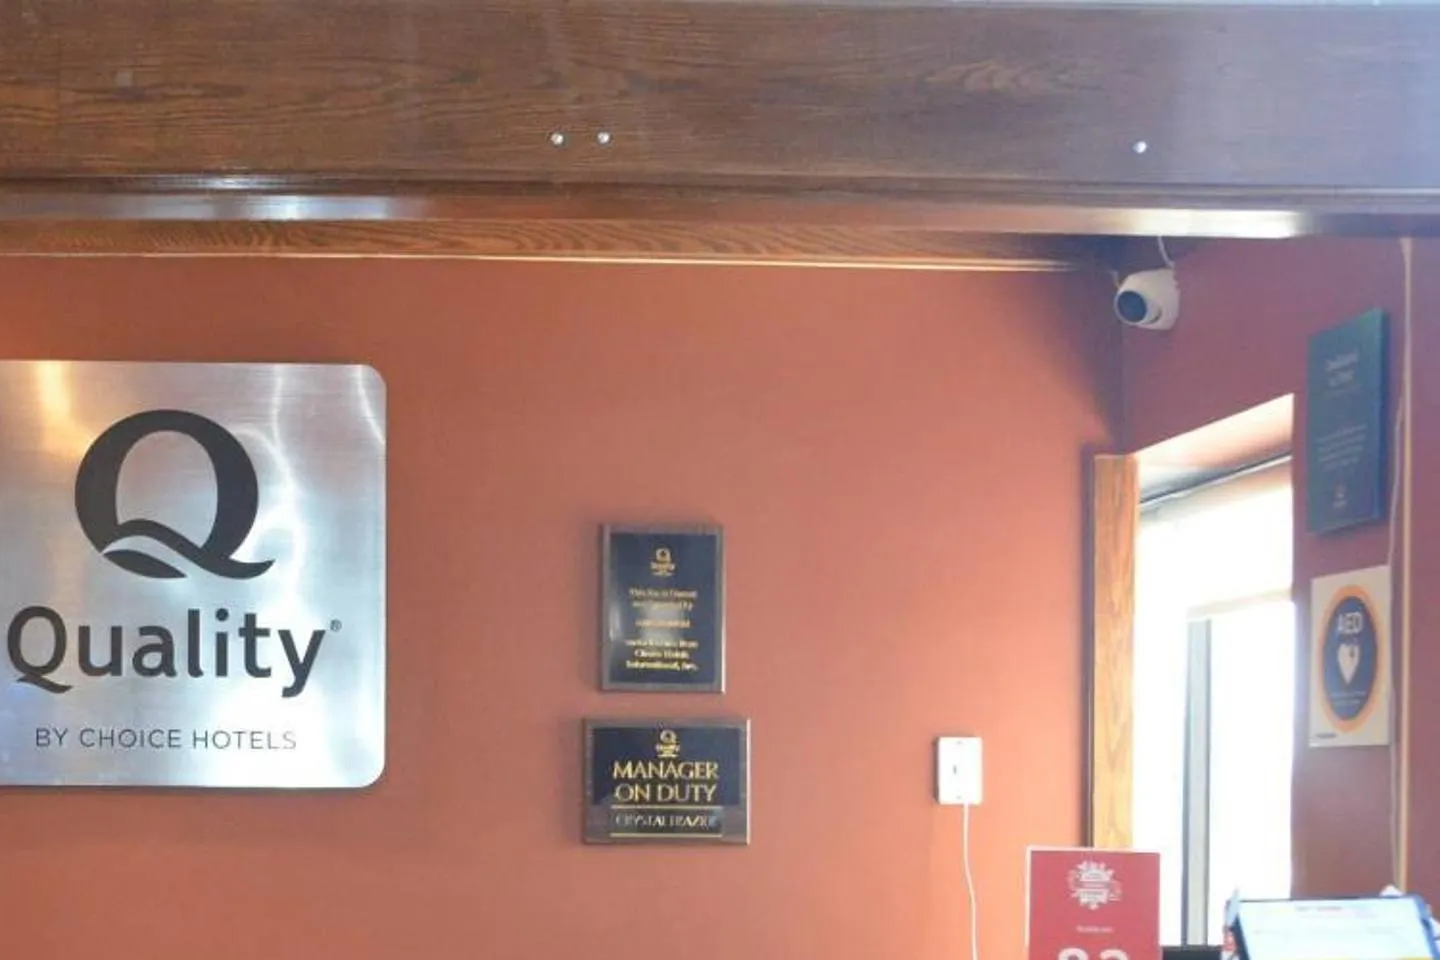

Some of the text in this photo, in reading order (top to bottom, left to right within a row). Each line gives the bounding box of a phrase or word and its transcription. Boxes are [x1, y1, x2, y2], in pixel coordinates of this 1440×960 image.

[6, 605, 327, 698] Quality
[35, 727, 297, 751] BY CHOICE HOTELS
[612, 760, 719, 780] MANAGER
[615, 783, 718, 803] ON DUTY
